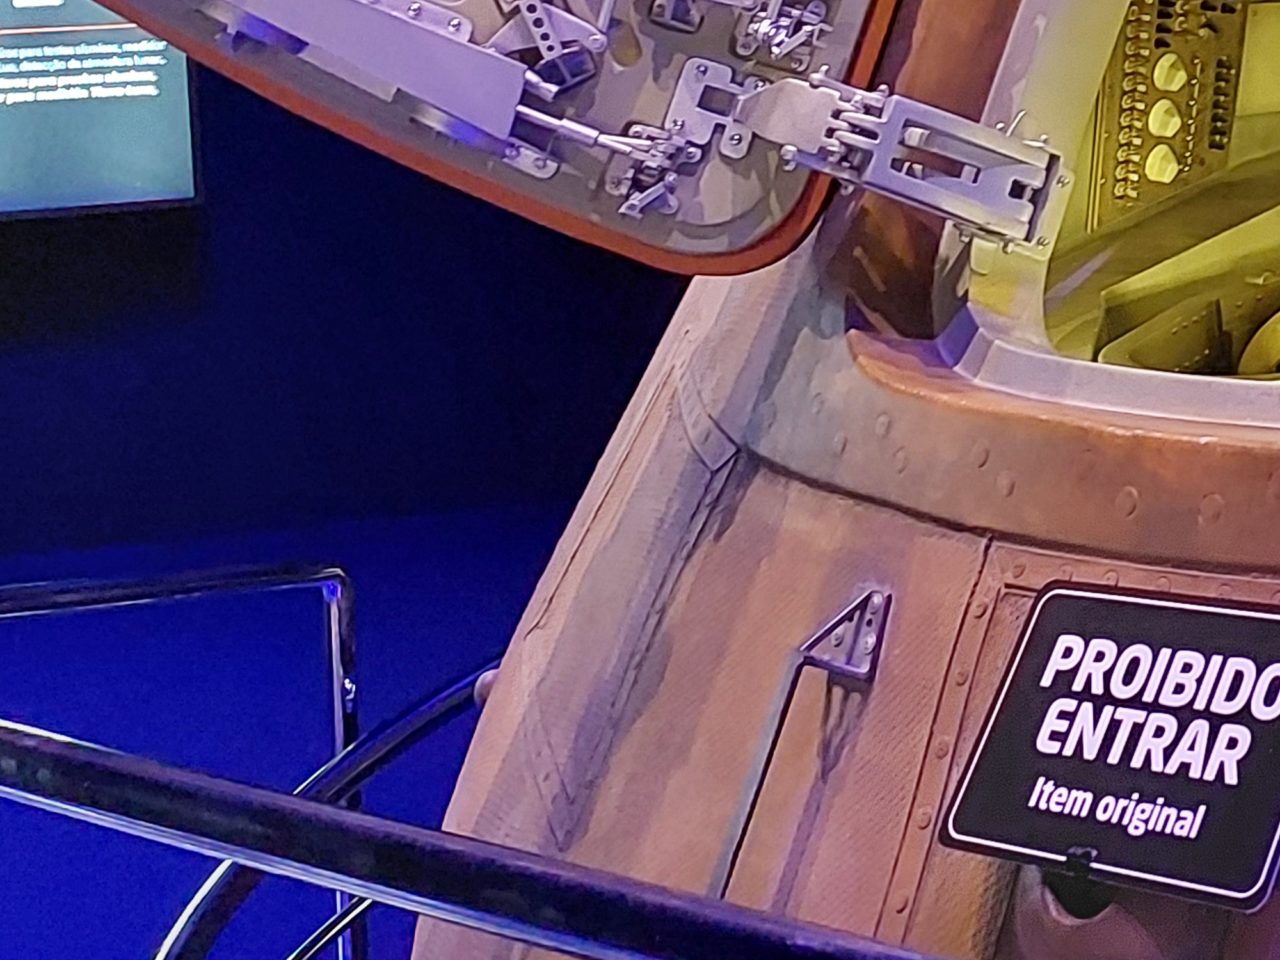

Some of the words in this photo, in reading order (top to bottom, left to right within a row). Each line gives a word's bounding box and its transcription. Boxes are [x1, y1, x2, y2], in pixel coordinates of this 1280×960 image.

[1036, 697, 1252, 786] ENTRAR
[1027, 776, 1094, 818] Item
[1095, 792, 1207, 839] original
